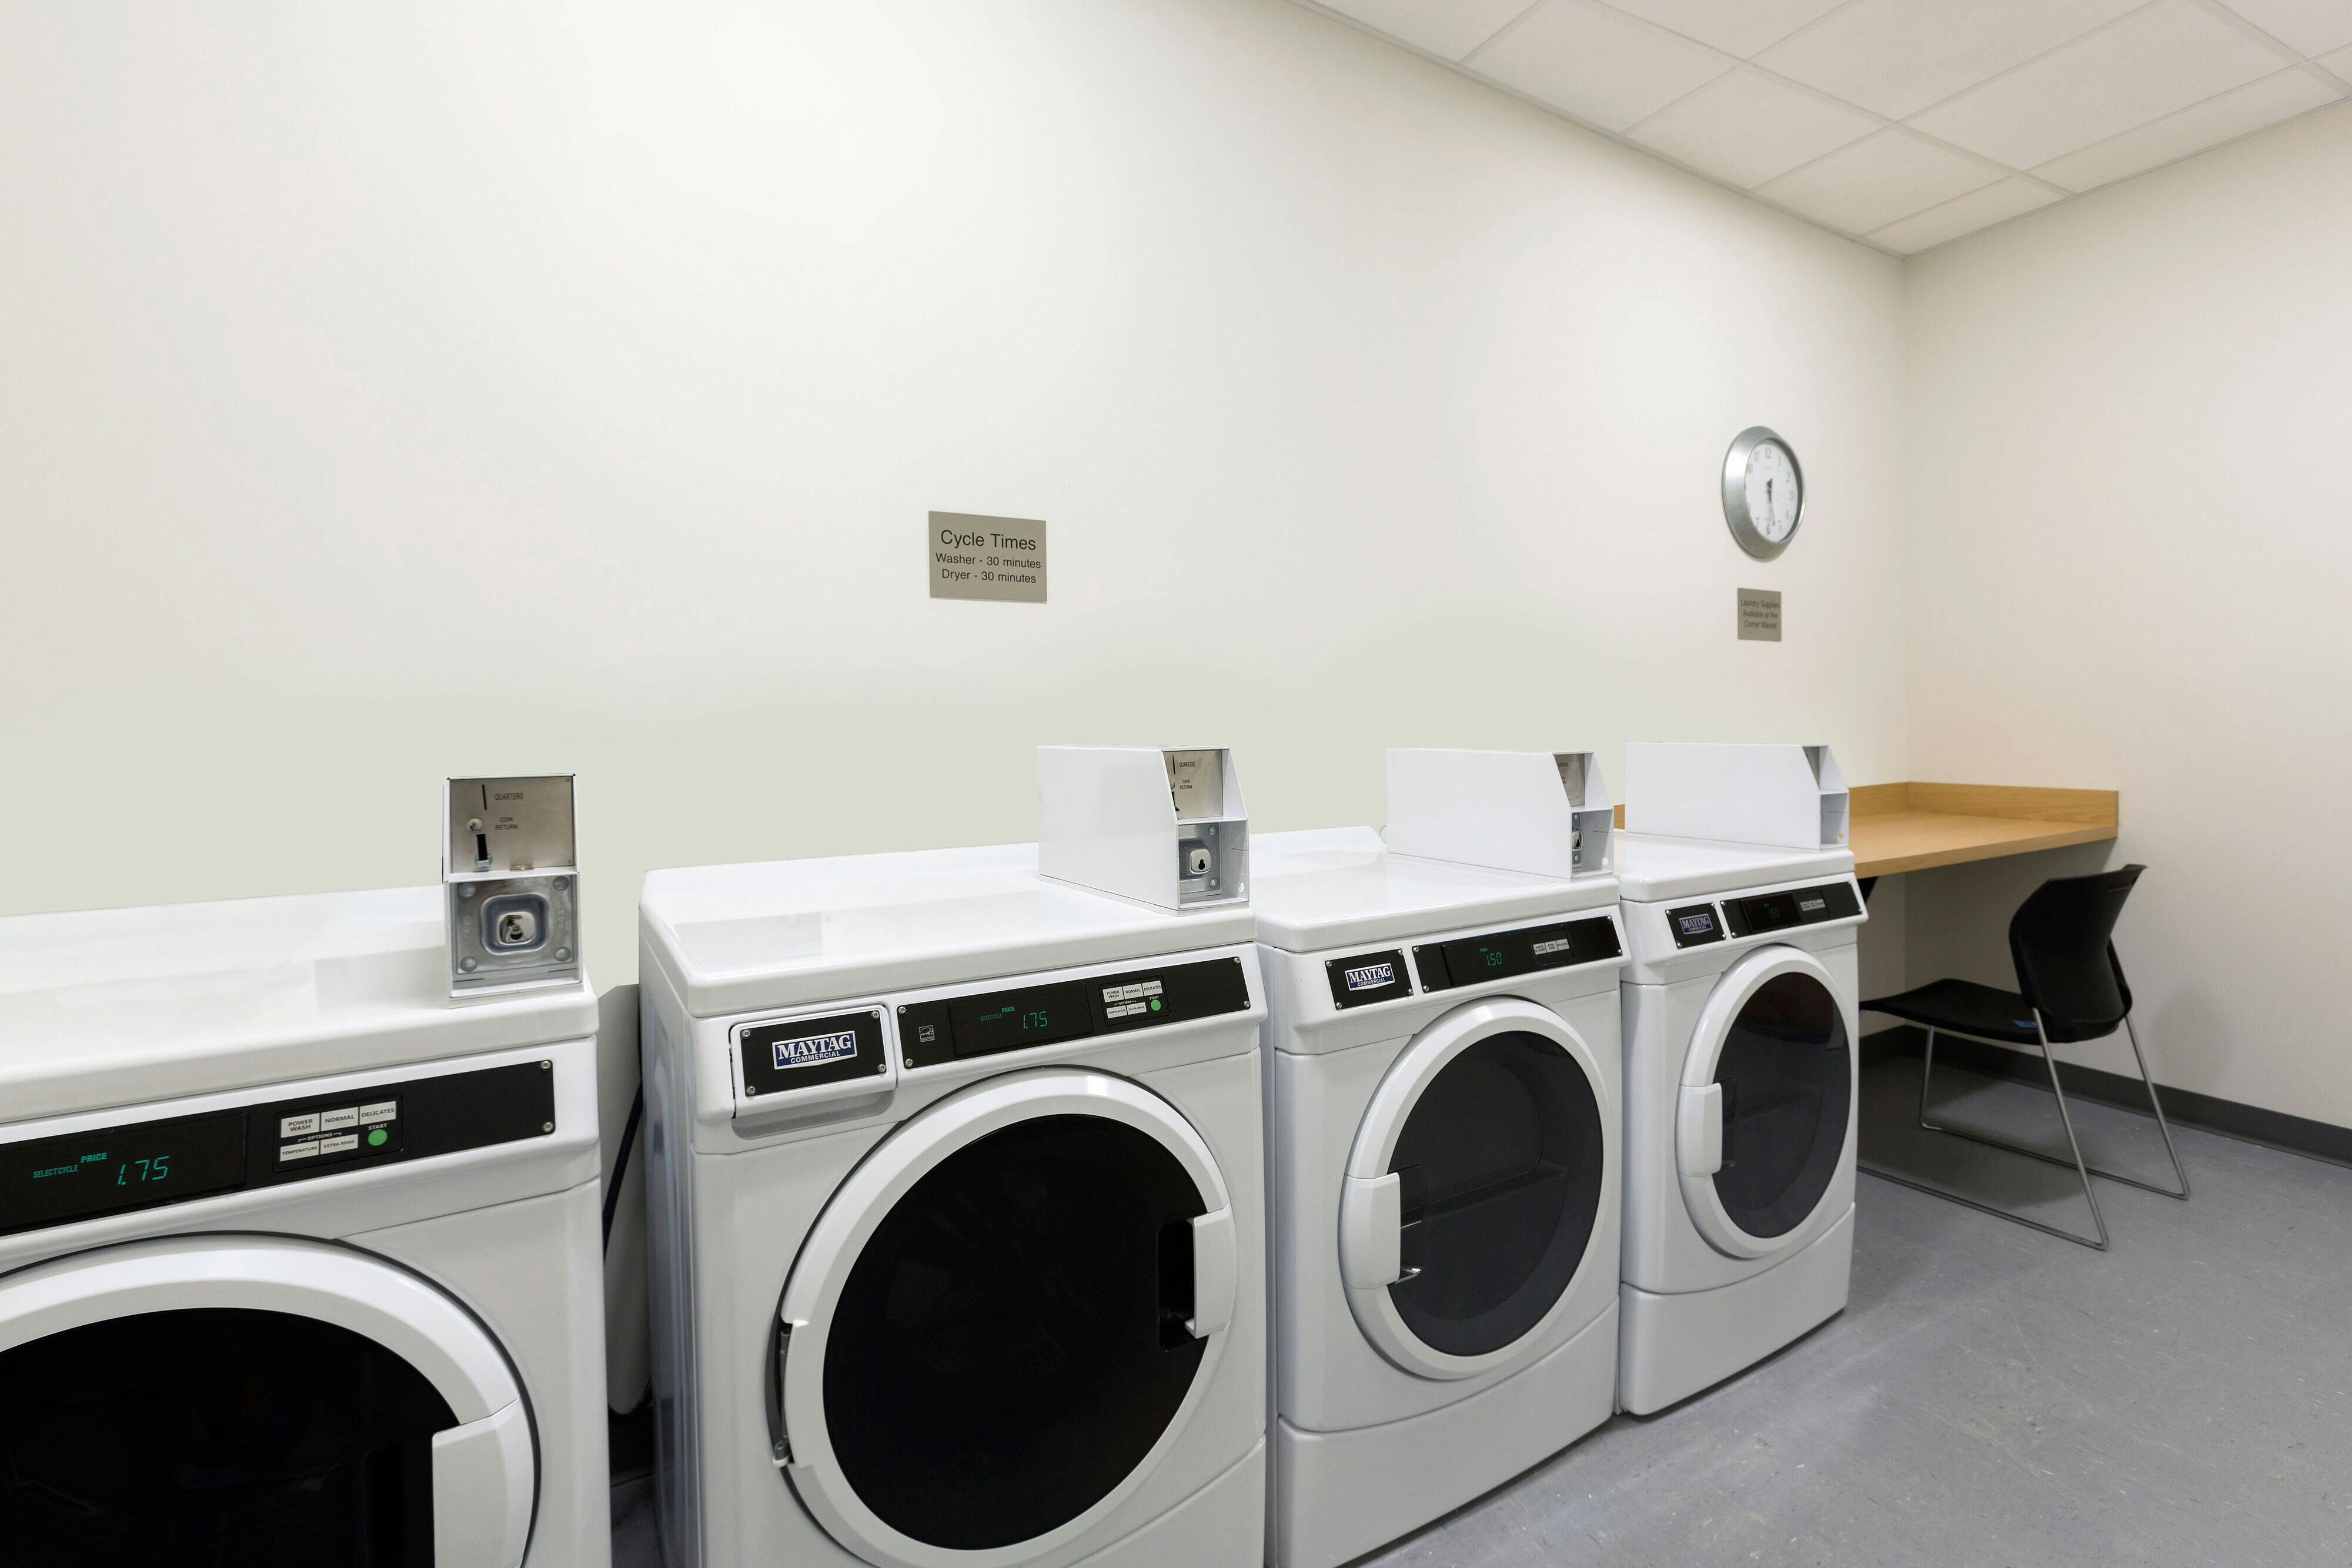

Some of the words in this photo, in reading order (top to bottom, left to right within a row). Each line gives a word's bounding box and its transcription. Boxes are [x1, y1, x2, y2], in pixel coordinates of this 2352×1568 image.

[941, 529, 984, 549] Cycle
[990, 533, 1036, 550] Times
[936, 553, 975, 564] Washer
[987, 556, 999, 566] 30
[1003, 558, 1041, 569] minutes
[942, 569, 970, 581] Dryer
[981, 571, 994, 581] 30
[998, 573, 1036, 583] minutes
[1740, 599, 1759, 608] Laundry
[495, 793, 523, 801] QUARTERS
[1682, 917, 1709, 929] MAYTAG
[1348, 967, 1391, 983] MAYTAG
[1358, 978, 1386, 986] COMMERCIAL
[1023, 1011, 1047, 1029] 1.75
[777, 1035, 852, 1059] MAYTAG
[790, 1051, 841, 1064] COMMERCIAL
[325, 1114, 355, 1124] NORMAL
[362, 1108, 395, 1118] DELICATES
[288, 1118, 313, 1127] POWER
[290, 1124, 311, 1132] WASH
[308, 1132, 333, 1141] OPTIONS
[282, 1146, 318, 1156] TEMPERATURE
[80, 1152, 108, 1164] PRICE
[33, 1168, 58, 1179] SELECT
[59, 1164, 79, 1175] CYCLE
[118, 1155, 170, 1185] 1.75
